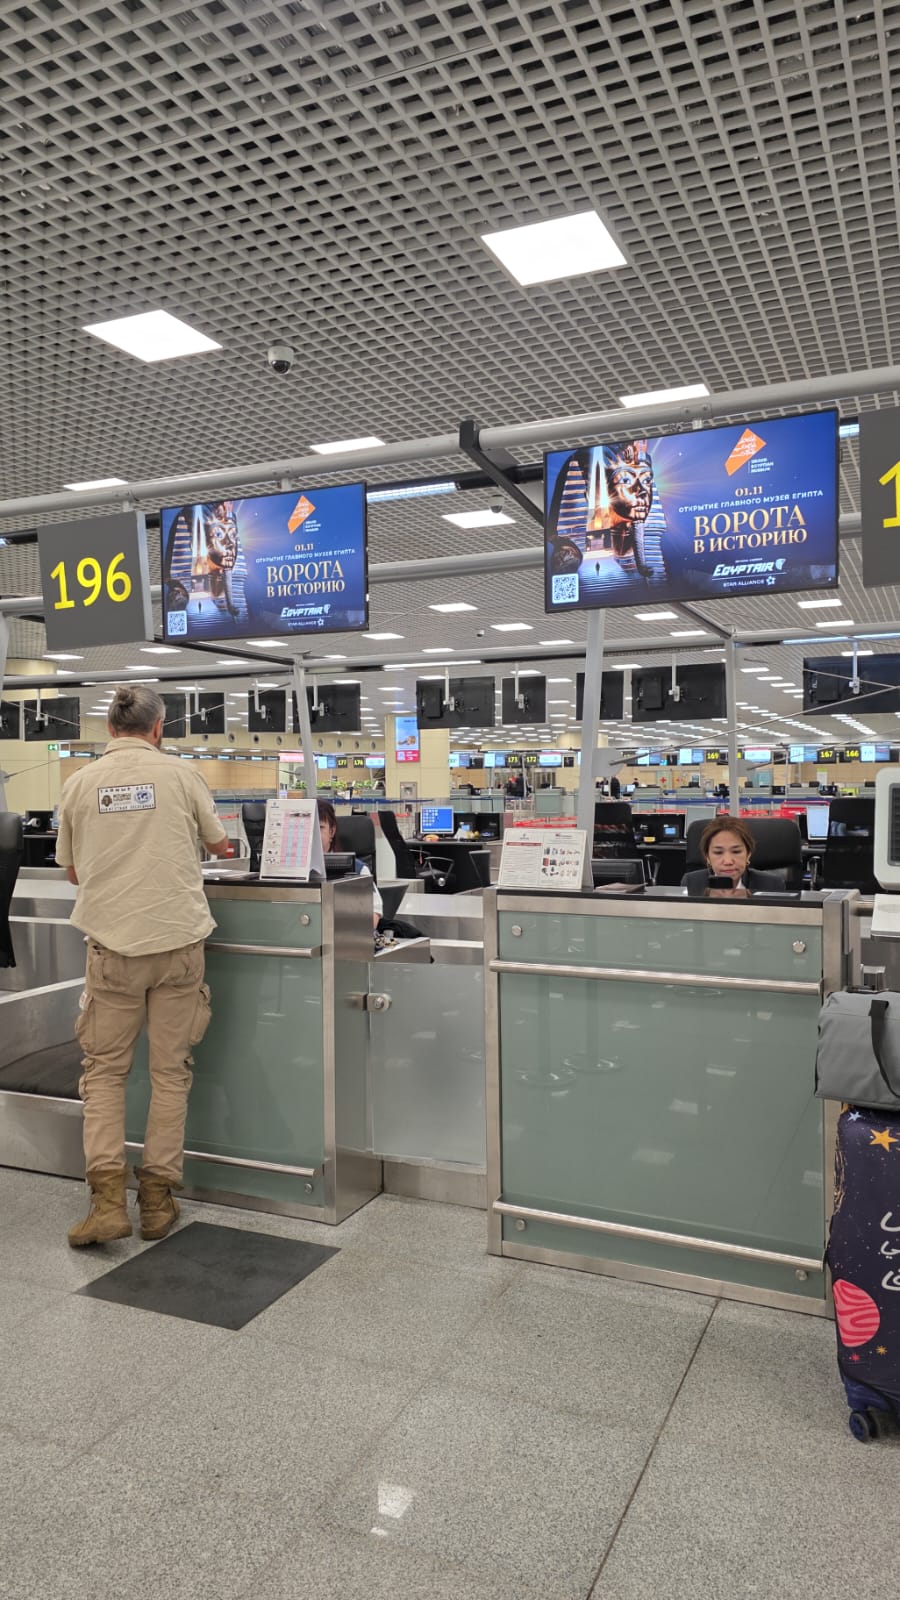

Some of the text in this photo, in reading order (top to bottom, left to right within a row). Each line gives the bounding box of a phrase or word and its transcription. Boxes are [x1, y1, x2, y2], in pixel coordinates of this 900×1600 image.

[678, 490, 824, 513] ОТКРЫТИЕ ГЛАВНОГО МУЗЕЯ ЕГИПТА
[735, 486, 763, 497] 01.11
[693, 504, 806, 538] ВОРОТА
[294, 543, 314, 551] 01.11
[693, 528, 807, 554] В ИСТОРИЮ
[333, 548, 355, 556] ЕГИПТА
[50, 552, 132, 610] 196
[266, 560, 344, 584] ВОРОТА
[267, 580, 345, 598] В ИСТОРИЮ
[820, 750, 833, 758] 167
